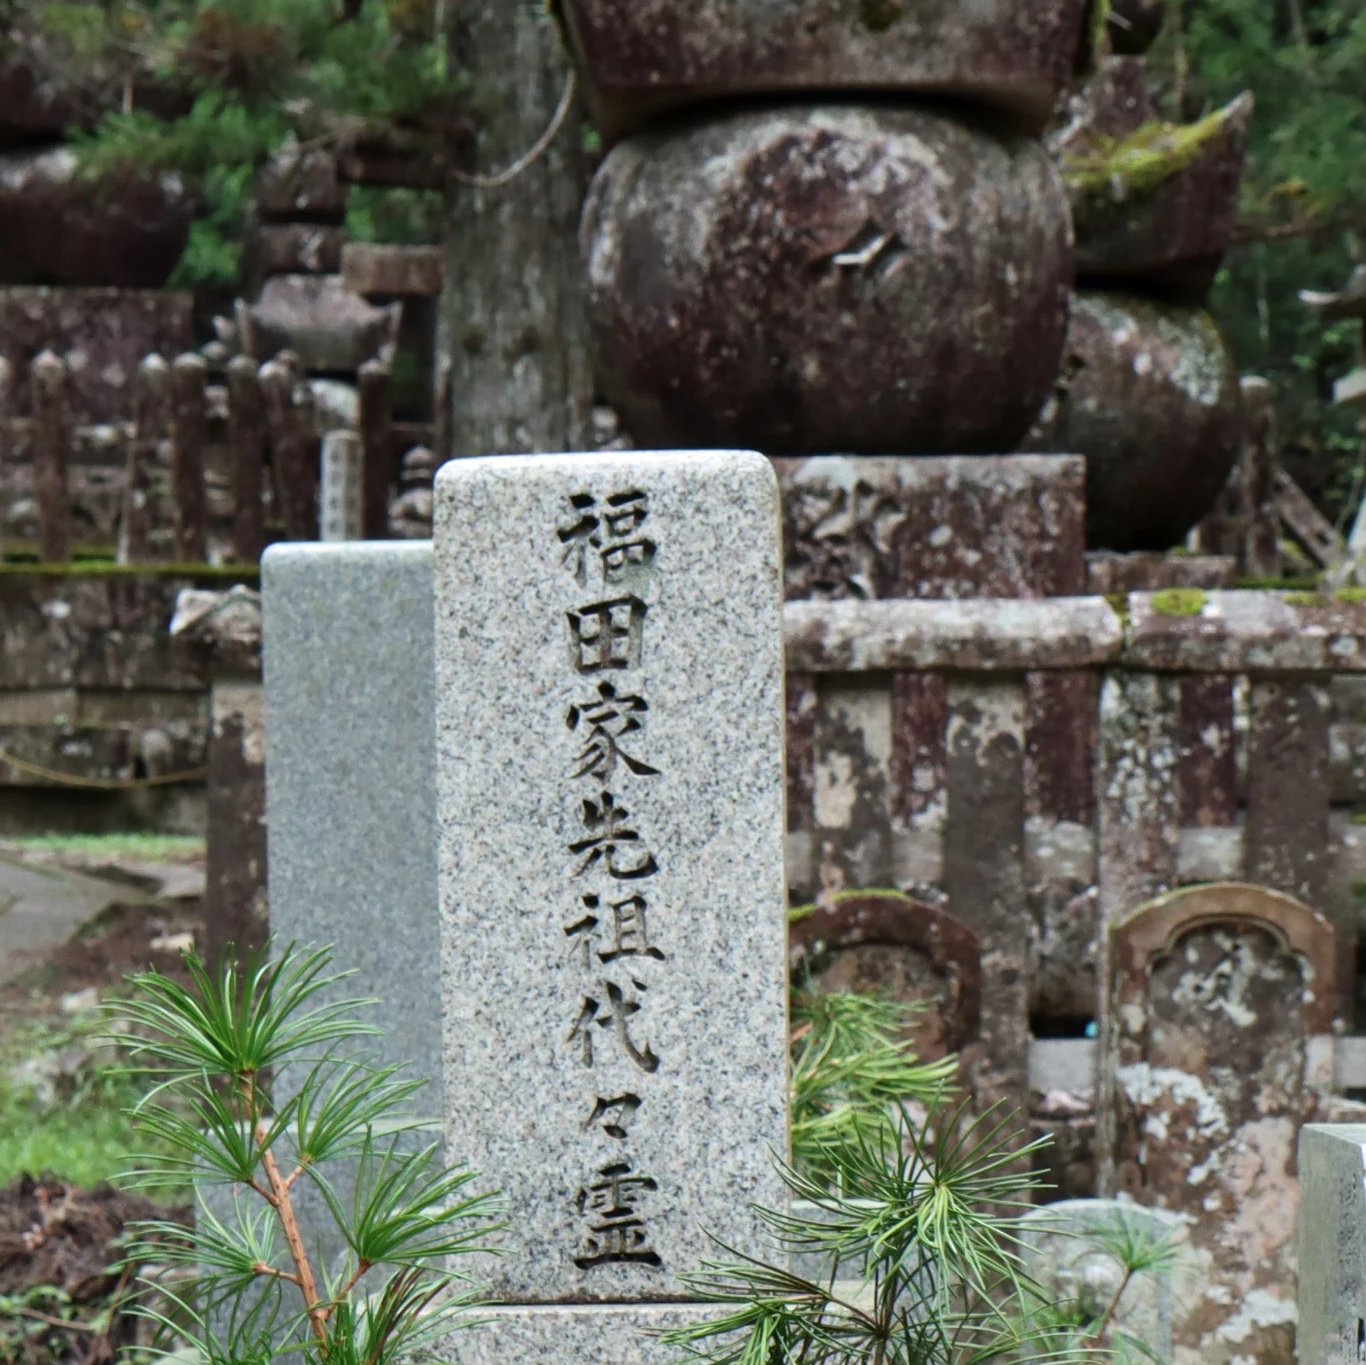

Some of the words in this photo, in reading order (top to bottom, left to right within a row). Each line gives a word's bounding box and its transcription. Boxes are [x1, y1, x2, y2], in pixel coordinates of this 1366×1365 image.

[557, 489, 664, 1270] 福田家先祖代々霊
